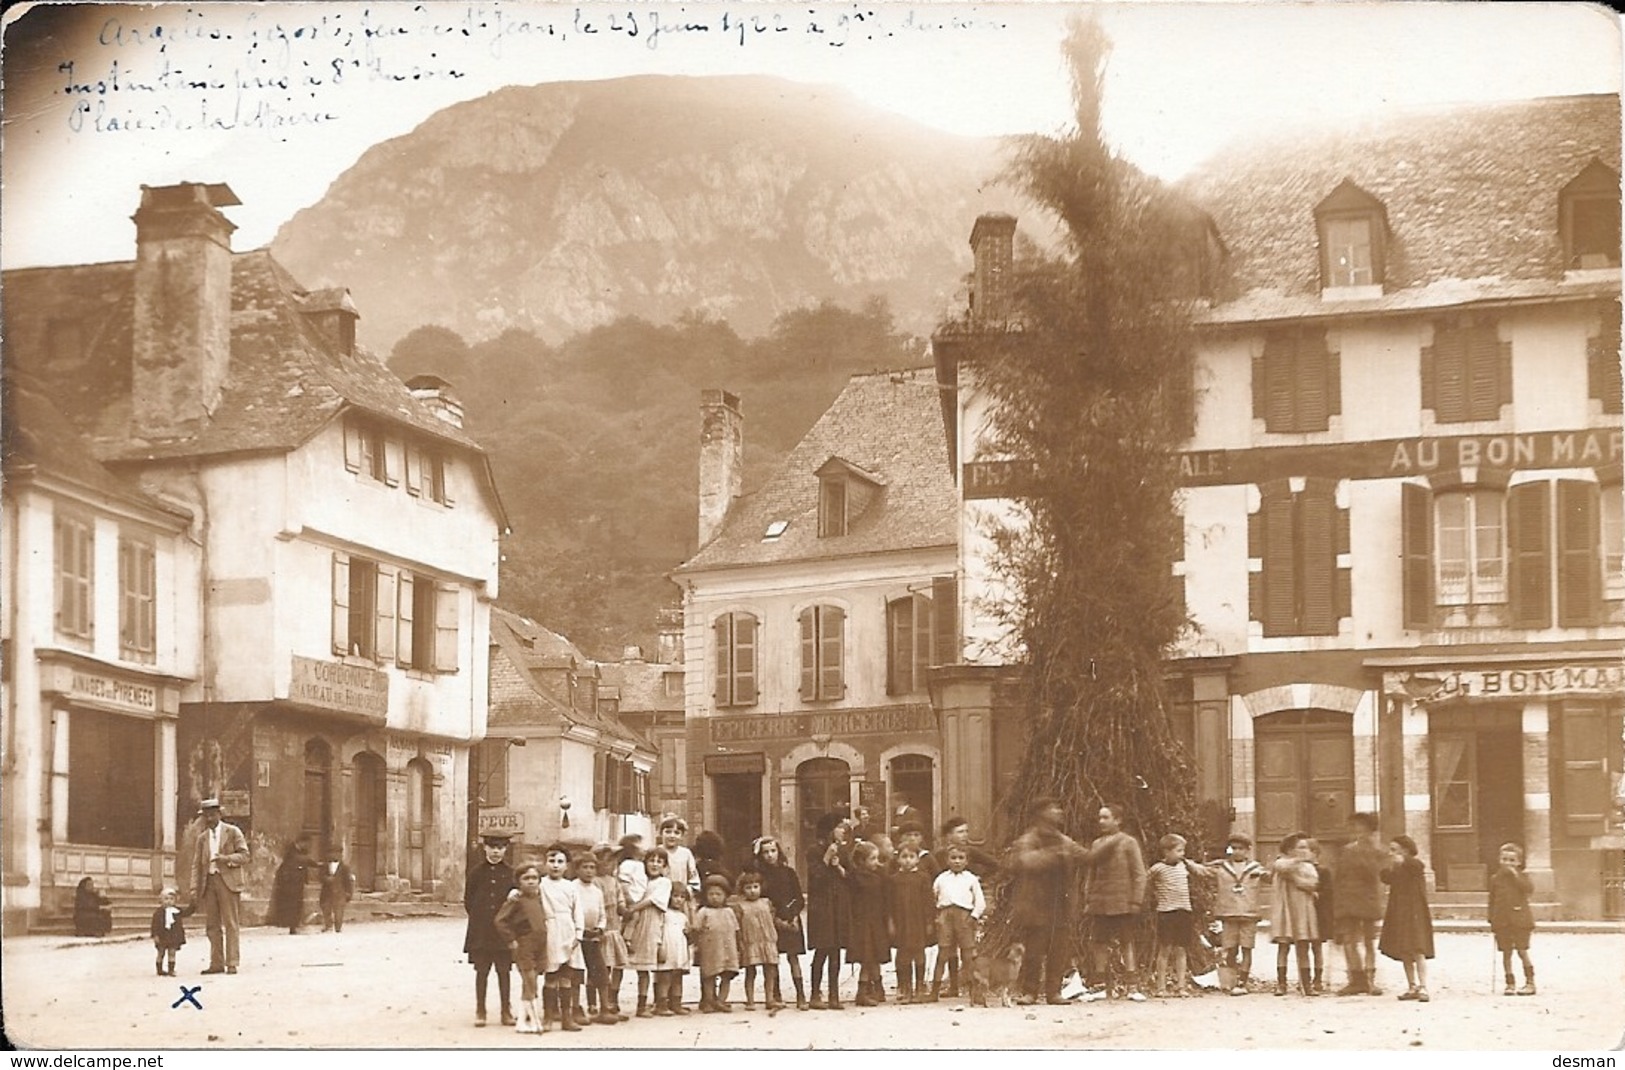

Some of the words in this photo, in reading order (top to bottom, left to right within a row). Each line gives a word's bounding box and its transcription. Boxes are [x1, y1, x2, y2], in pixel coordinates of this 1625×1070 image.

[574, 8, 599, 34] le
[722, 12, 788, 46] 1922
[1390, 441, 1440, 471] AU
[1458, 435, 1536, 467] BON
[1481, 669, 1560, 693] BON
